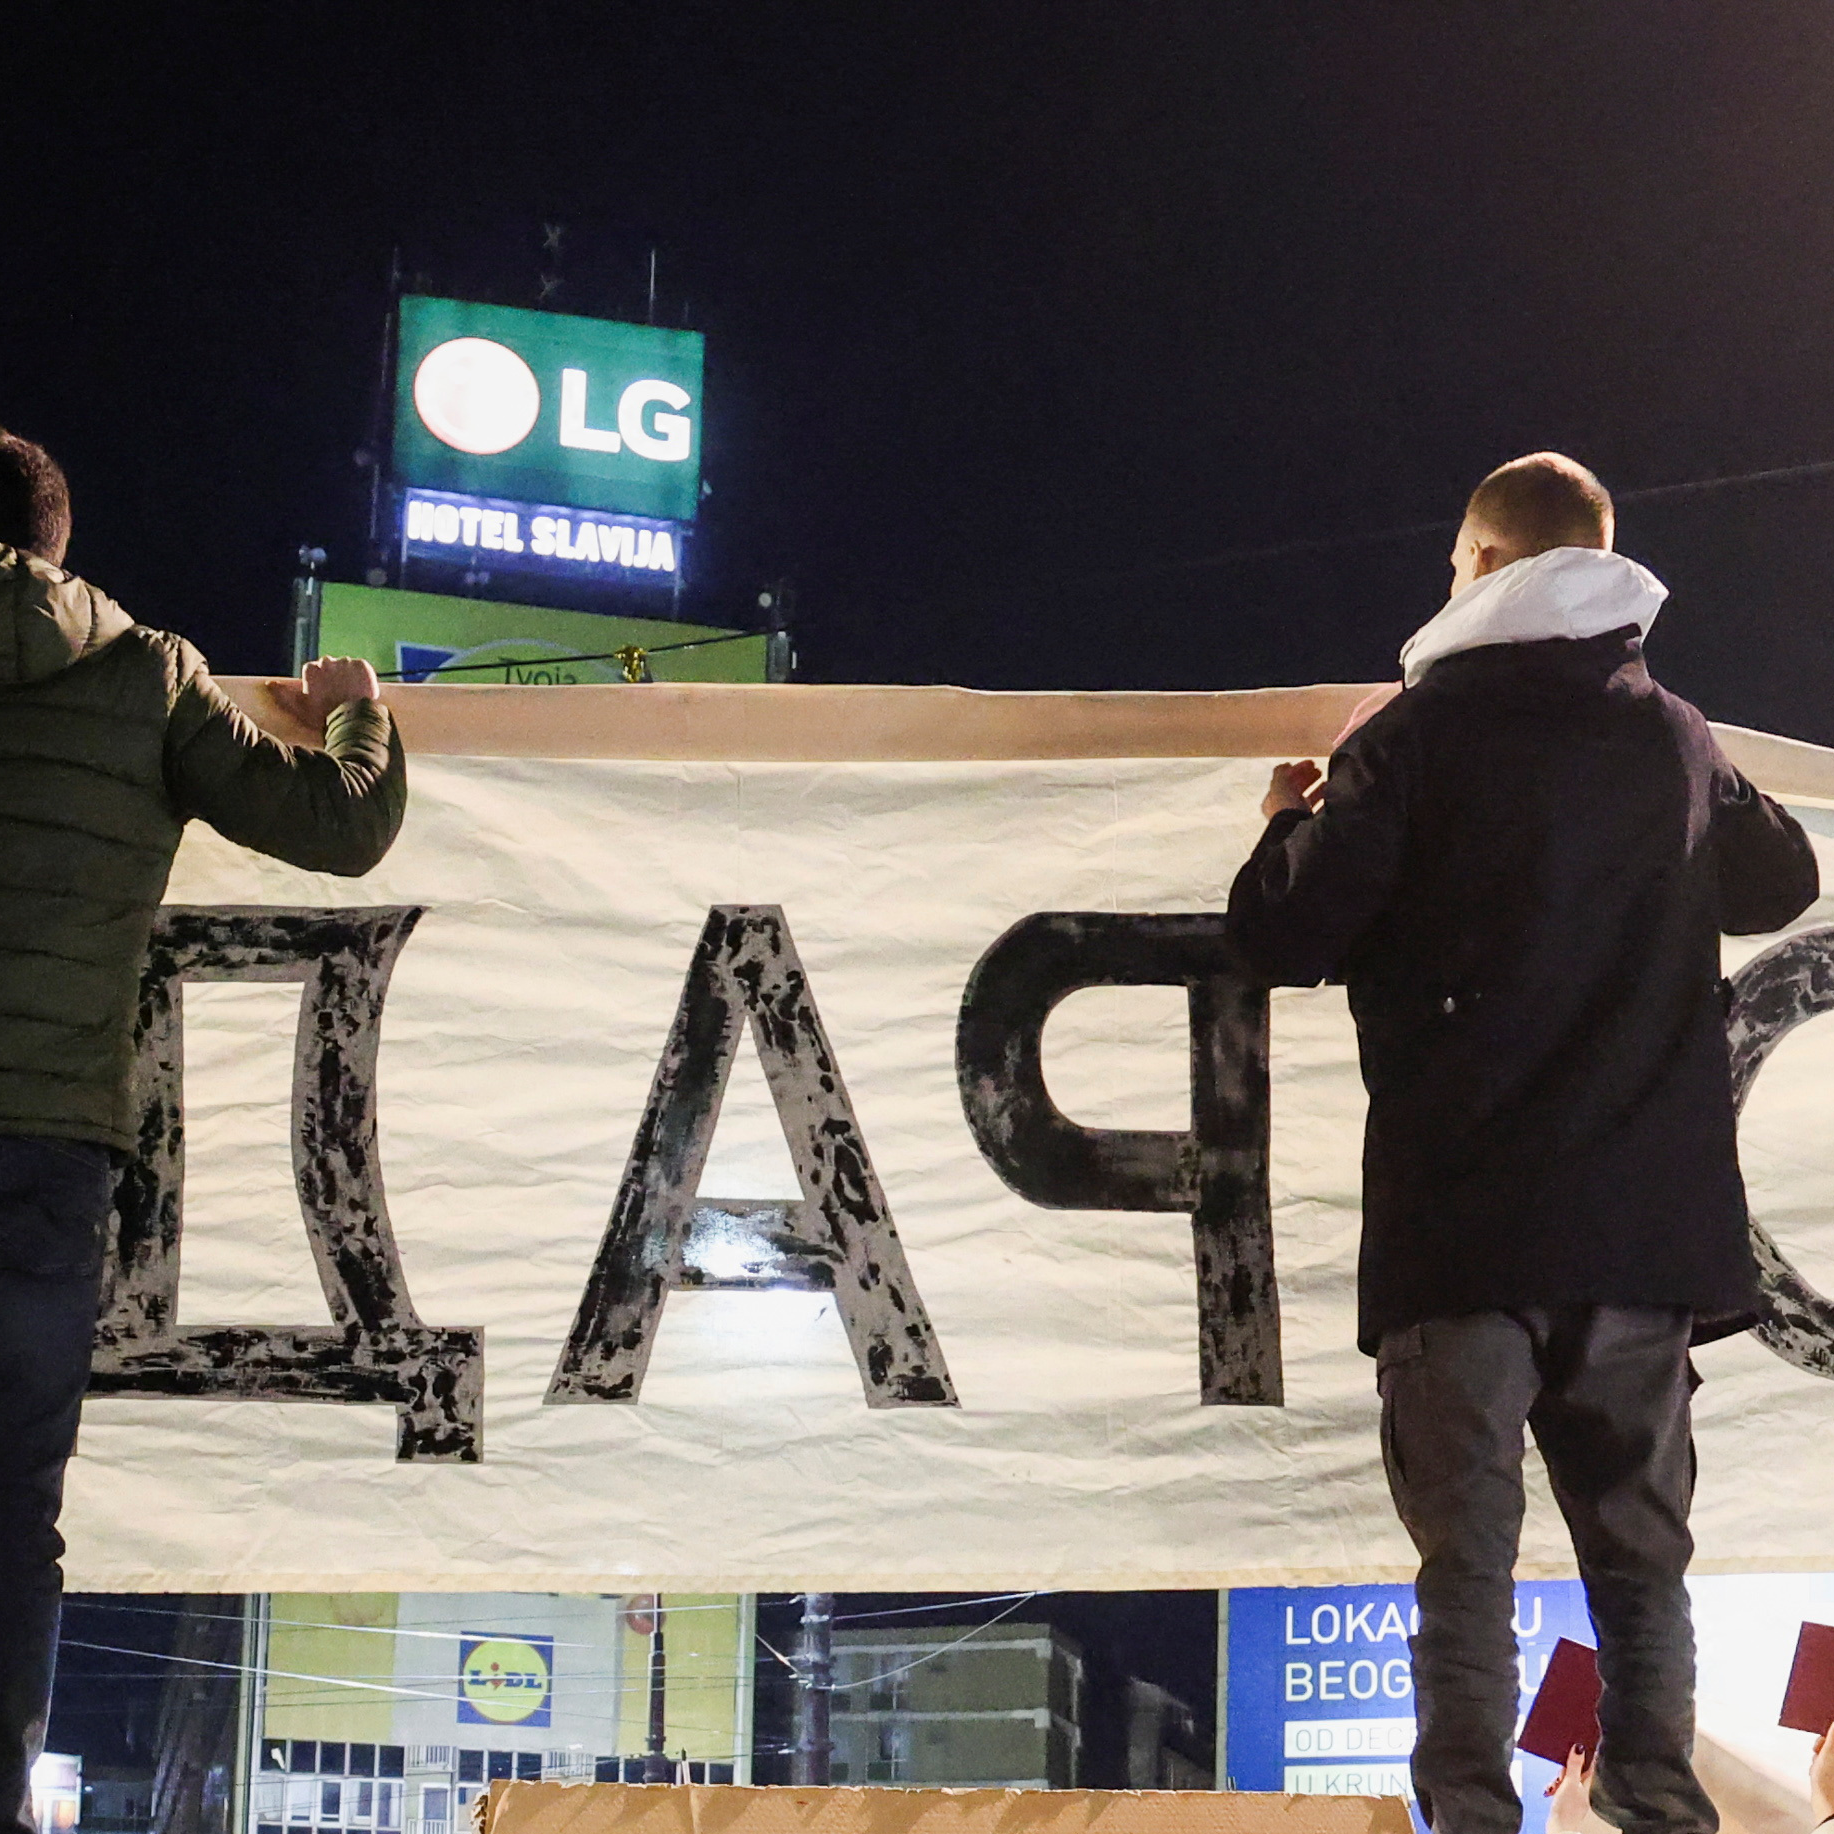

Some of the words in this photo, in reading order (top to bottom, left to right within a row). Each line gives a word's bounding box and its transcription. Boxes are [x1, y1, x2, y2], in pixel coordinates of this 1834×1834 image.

[559, 368, 691, 462] LG
[407, 500, 524, 553] HOTEL
[531, 515, 675, 571] SLAVIJA
[1295, 1728, 1334, 1752] OD
